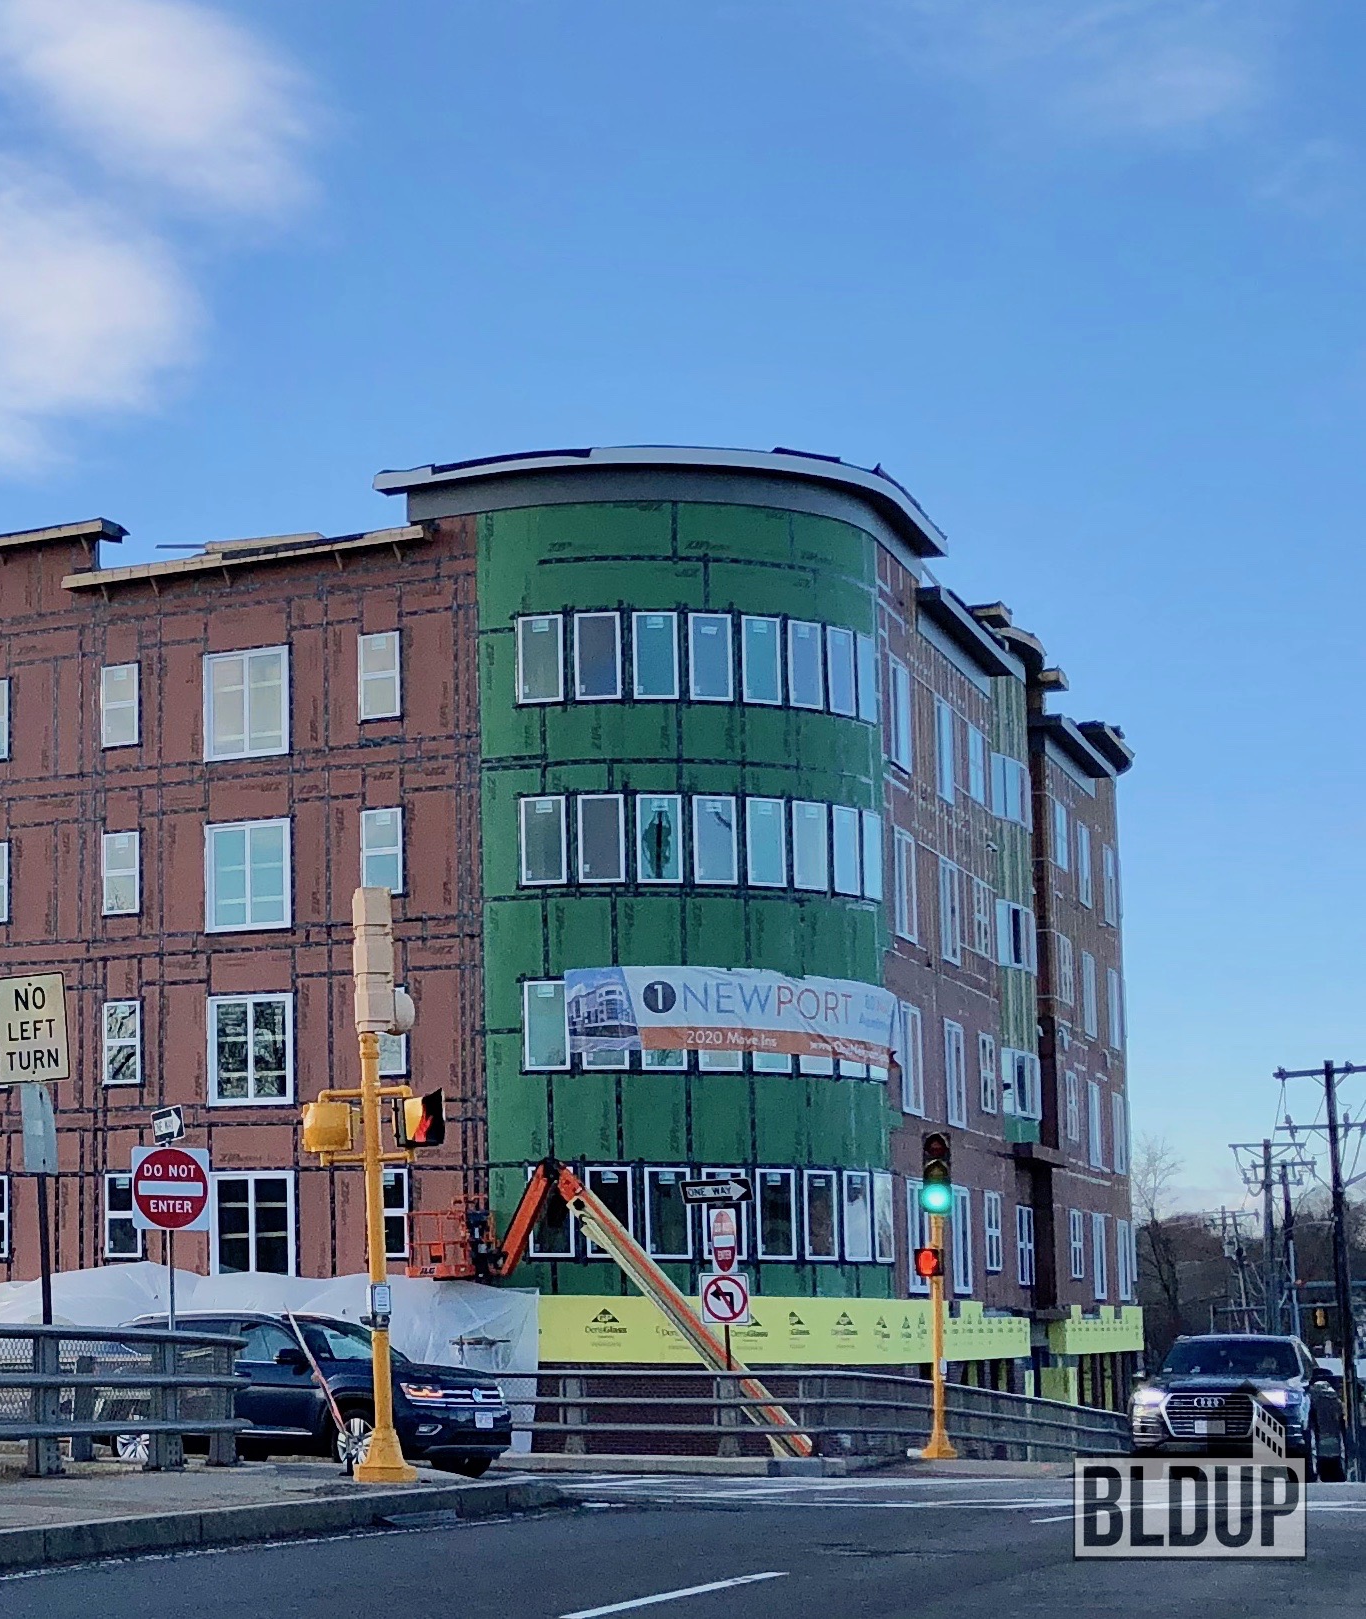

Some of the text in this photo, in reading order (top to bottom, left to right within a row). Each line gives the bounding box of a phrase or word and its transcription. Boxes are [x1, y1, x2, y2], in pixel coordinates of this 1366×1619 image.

[14, 986, 46, 1012] NO
[682, 981, 853, 1025] NEWPORT
[7, 1018, 56, 1042] LEFT
[686, 1030, 723, 1044] 2020
[6, 1047, 59, 1071] TURN
[143, 1163, 196, 1178] DO NOT
[687, 1185, 732, 1197] ONE WAY
[149, 1199, 193, 1214] ENTER
